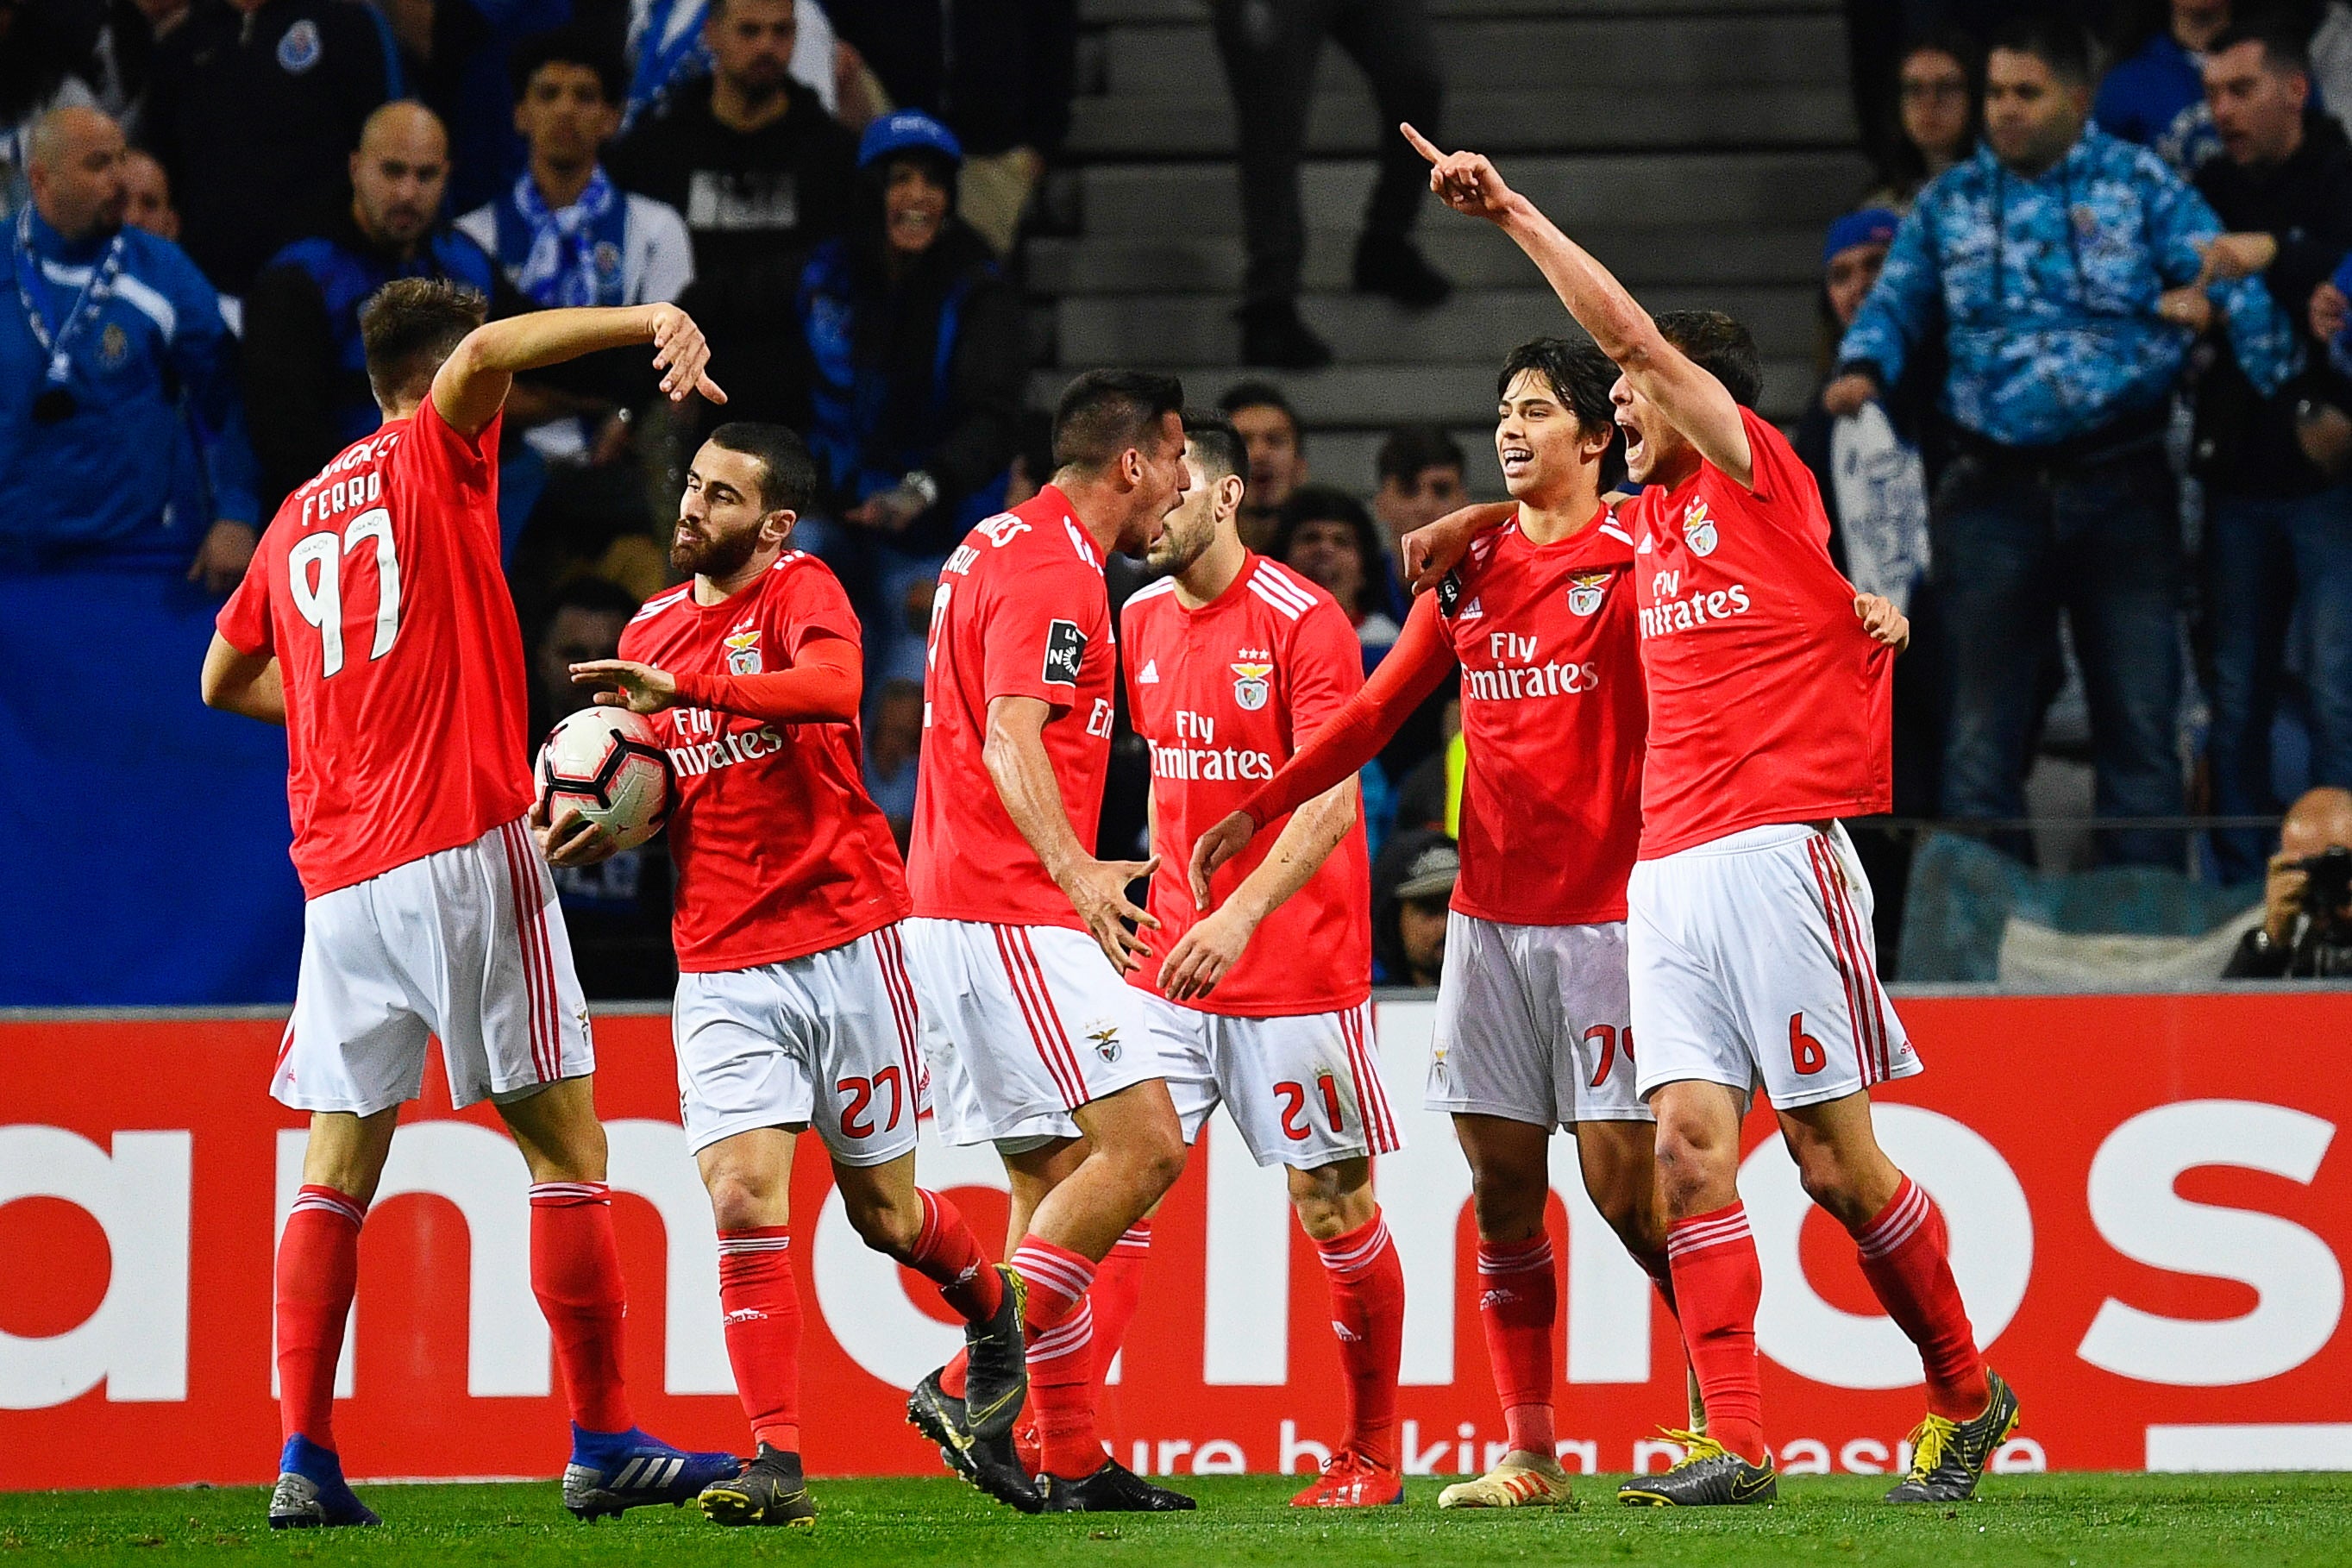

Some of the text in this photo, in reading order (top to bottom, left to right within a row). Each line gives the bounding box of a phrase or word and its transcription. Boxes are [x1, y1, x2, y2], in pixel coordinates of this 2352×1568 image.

[302, 471, 380, 526] FERRO
[288, 506, 401, 680] 97
[1653, 570, 1679, 598] Fly
[1490, 632, 1538, 663] Fly
[673, 707, 713, 737] Fly
[1176, 710, 1214, 745] Fly
[1147, 738, 1274, 781] Emirates
[1789, 1011, 1827, 1075] 6
[837, 1065, 902, 1138] 27
[1272, 1075, 1344, 1141] 21
